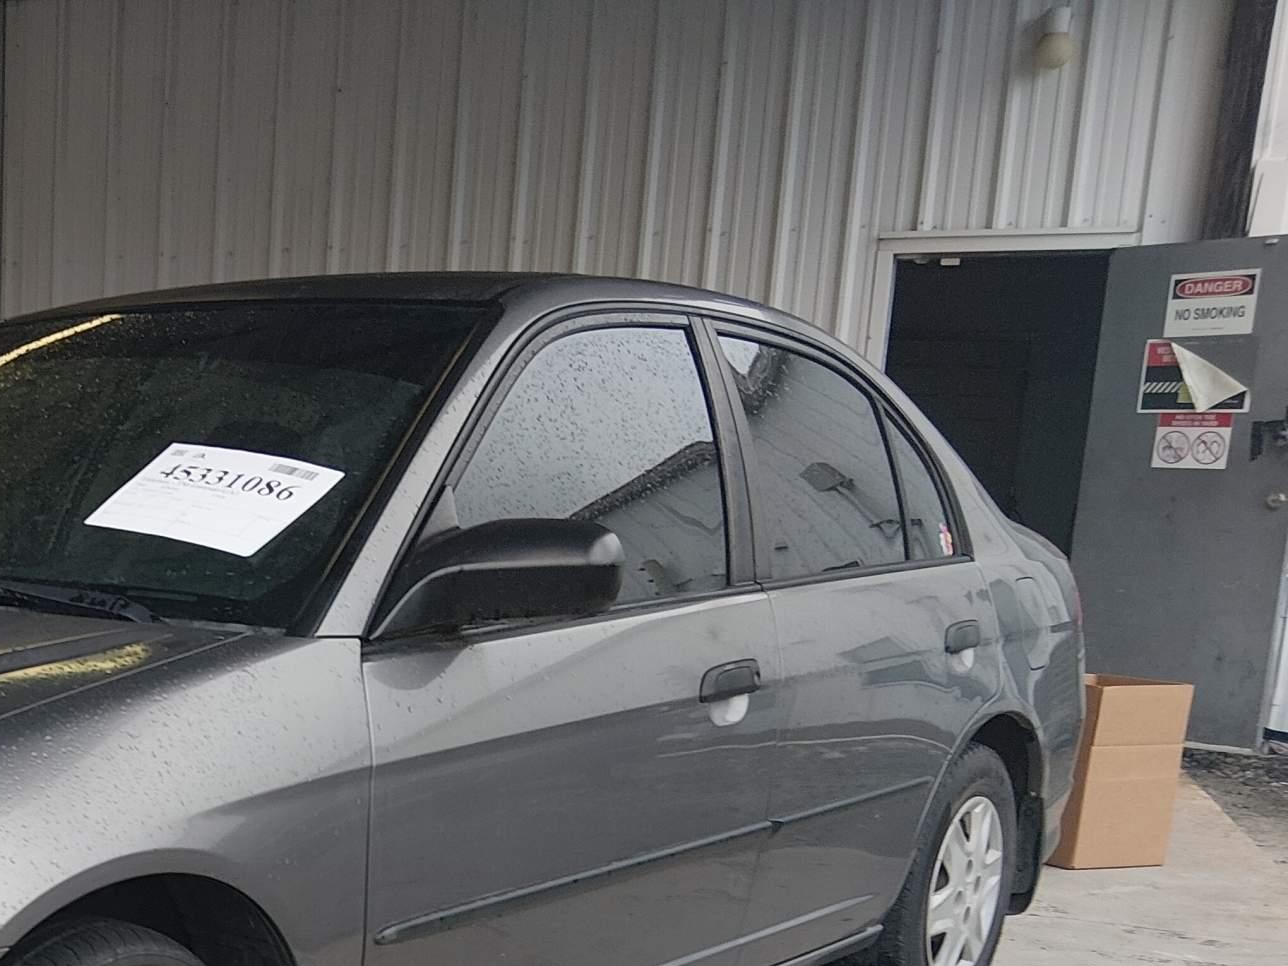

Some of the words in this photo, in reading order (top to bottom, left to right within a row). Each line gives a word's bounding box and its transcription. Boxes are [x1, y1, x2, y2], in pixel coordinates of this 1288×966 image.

[1184, 280, 1243, 295] DANGER
[1175, 308, 1191, 321] NO
[1193, 305, 1246, 320] SMOKING
[159, 463, 301, 501] 45331086
